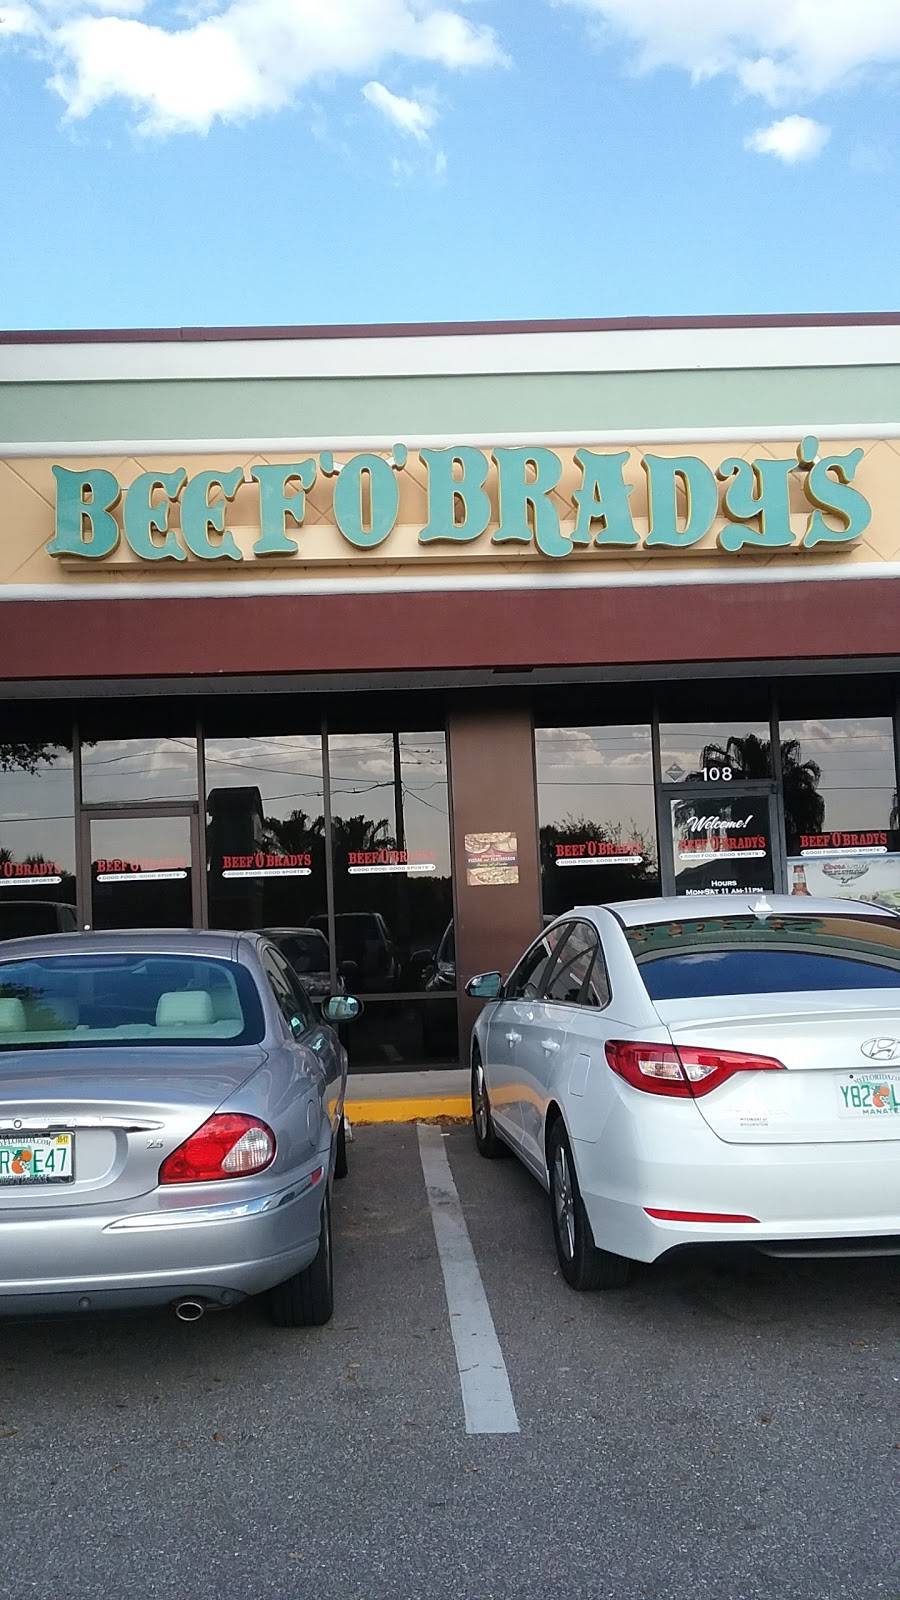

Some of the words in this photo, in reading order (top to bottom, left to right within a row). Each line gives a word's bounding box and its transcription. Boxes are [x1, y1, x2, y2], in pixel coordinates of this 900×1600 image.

[418, 436, 872, 558] BRADY'S
[700, 766, 733, 782] 108
[686, 814, 754, 833] Welcome!
[800, 835, 830, 848] BEEF
[348, 852, 379, 865] BEEF
[554, 844, 586, 857] BEEF
[223, 855, 254, 869] BEEF
[840, 1084, 873, 1108] Y82
[33, 1147, 67, 1173] E47
